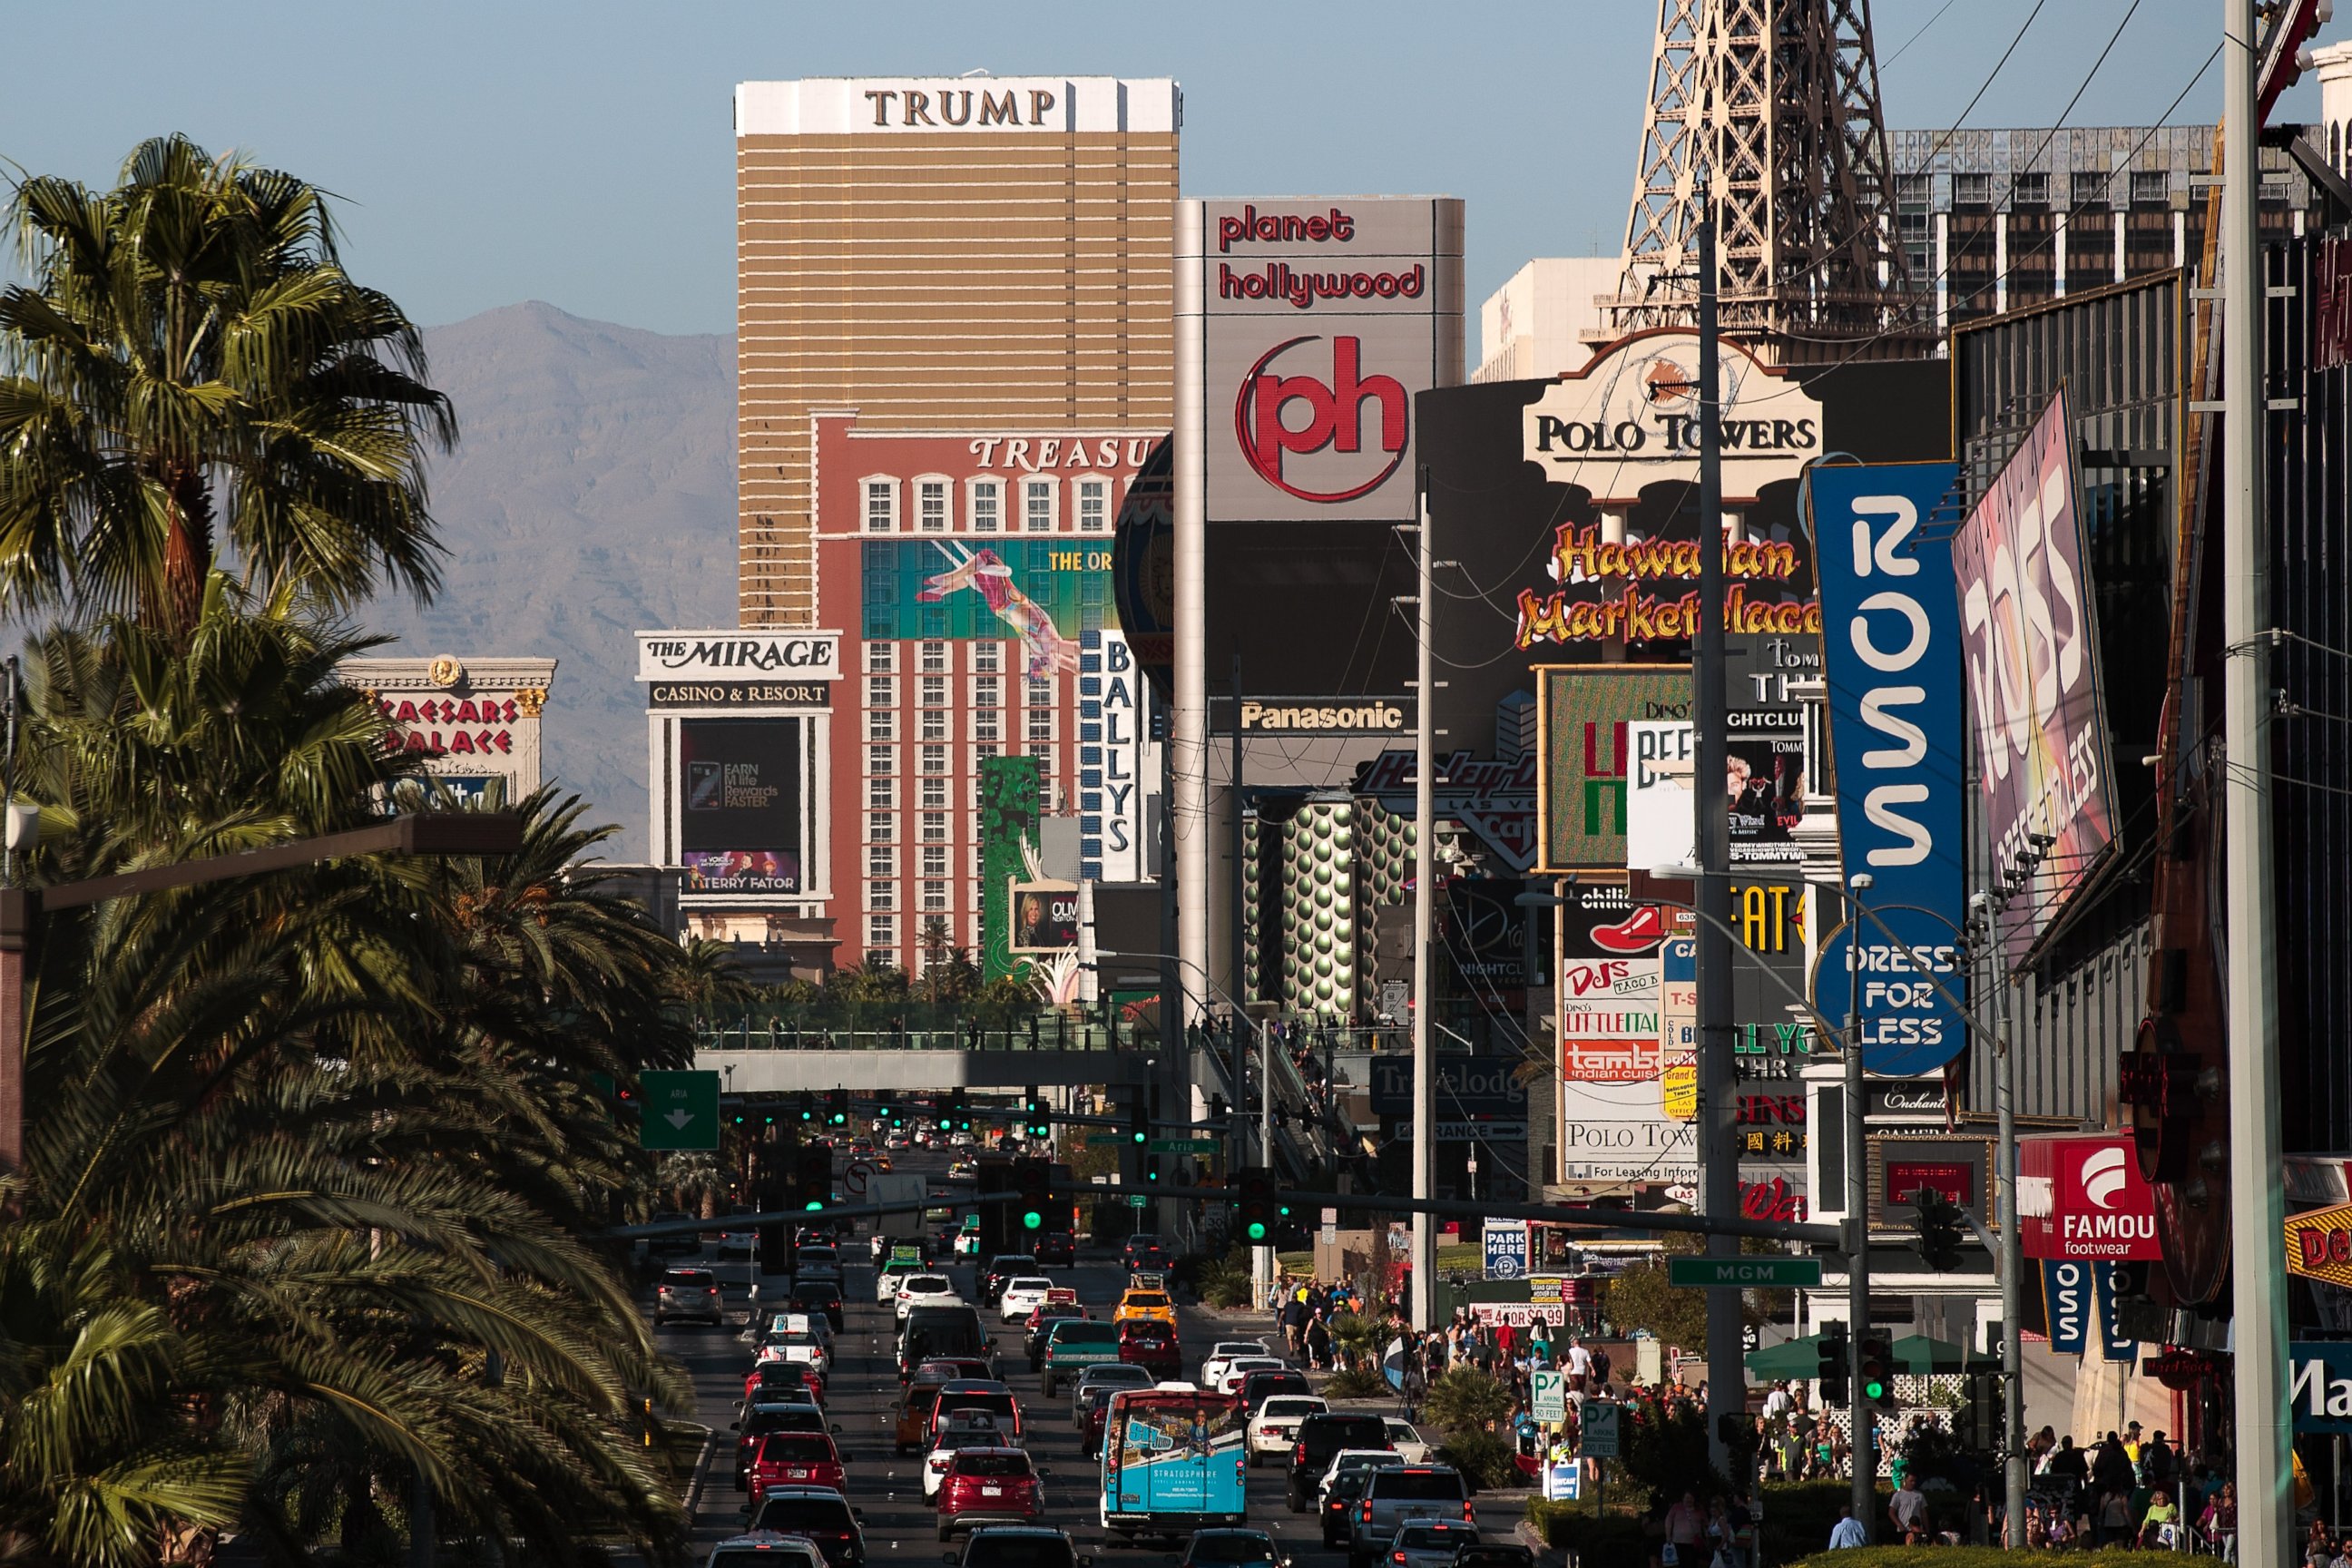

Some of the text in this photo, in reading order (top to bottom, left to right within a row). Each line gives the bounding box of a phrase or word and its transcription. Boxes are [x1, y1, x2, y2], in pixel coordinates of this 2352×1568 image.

[865, 89, 1055, 126] TRUMP
[1219, 205, 1355, 253] planet
[1219, 263, 1426, 308] hollywood
[1255, 336, 1409, 484] ph
[1535, 415, 1645, 452] POLO
[1554, 522, 1801, 583] Hawaian
[1049, 552, 1112, 572] THE OR
[1514, 581, 1822, 652] Marketlace
[1965, 464, 2082, 796] ROSS
[647, 641, 832, 671] THE MIRAGE
[1849, 495, 1933, 867] ROSS
[653, 686, 825, 702] CASINO & RESORT
[1241, 701, 1402, 729] Panasonic
[1103, 641, 1132, 852] BALLYS
[724, 763, 760, 776] EARN
[724, 774, 758, 786] M life
[2036, 765, 2067, 838] FOR
[2063, 720, 2098, 820] LESS
[724, 785, 779, 797] Rewards
[1449, 799, 1492, 810] LAS
[1778, 816, 1799, 827] EVIL
[704, 877, 795, 889] TERRY FATOR
[1846, 946, 1955, 973] DRESS
[1615, 977, 1647, 991] TACO
[1866, 981, 1935, 1009] FOR
[1861, 1017, 1943, 1045] LESS
[1566, 1042, 1660, 1070] tamb
[1572, 1068, 1660, 1079] indian cuisi
[1666, 1069, 1690, 1081] Grand
[1734, 1057, 1788, 1078] HR
[1376, 1063, 1524, 1103] Trelodg
[670, 1089, 688, 1099] ARIA
[1399, 1125, 1488, 1137] ERANCE
[1568, 1123, 1634, 1147] POLO
[1169, 1142, 1194, 1152] Aria
[1594, 1167, 1613, 1177] For
[1616, 1166, 1661, 1180] Leasing
[1674, 1191, 1693, 1199] LAS
[1208, 1218, 1223, 1227] 30
[2063, 1214, 2155, 1240] FAMOU
[1486, 1232, 1525, 1244] PARK
[1486, 1244, 1525, 1255] HERE
[2064, 1240, 2132, 1255] footwear
[1716, 1265, 1774, 1280] MGM
[1494, 1309, 1503, 1325] 4
[1527, 1309, 1563, 1325] $99
[2147, 1359, 2215, 1376] Hard Rock
[1535, 1374, 1549, 1401] P
[1535, 1408, 1561, 1418] 50 FEET
[1598, 1444, 1615, 1453] FEET
[1153, 1469, 1217, 1478] STRATOSPHERE
